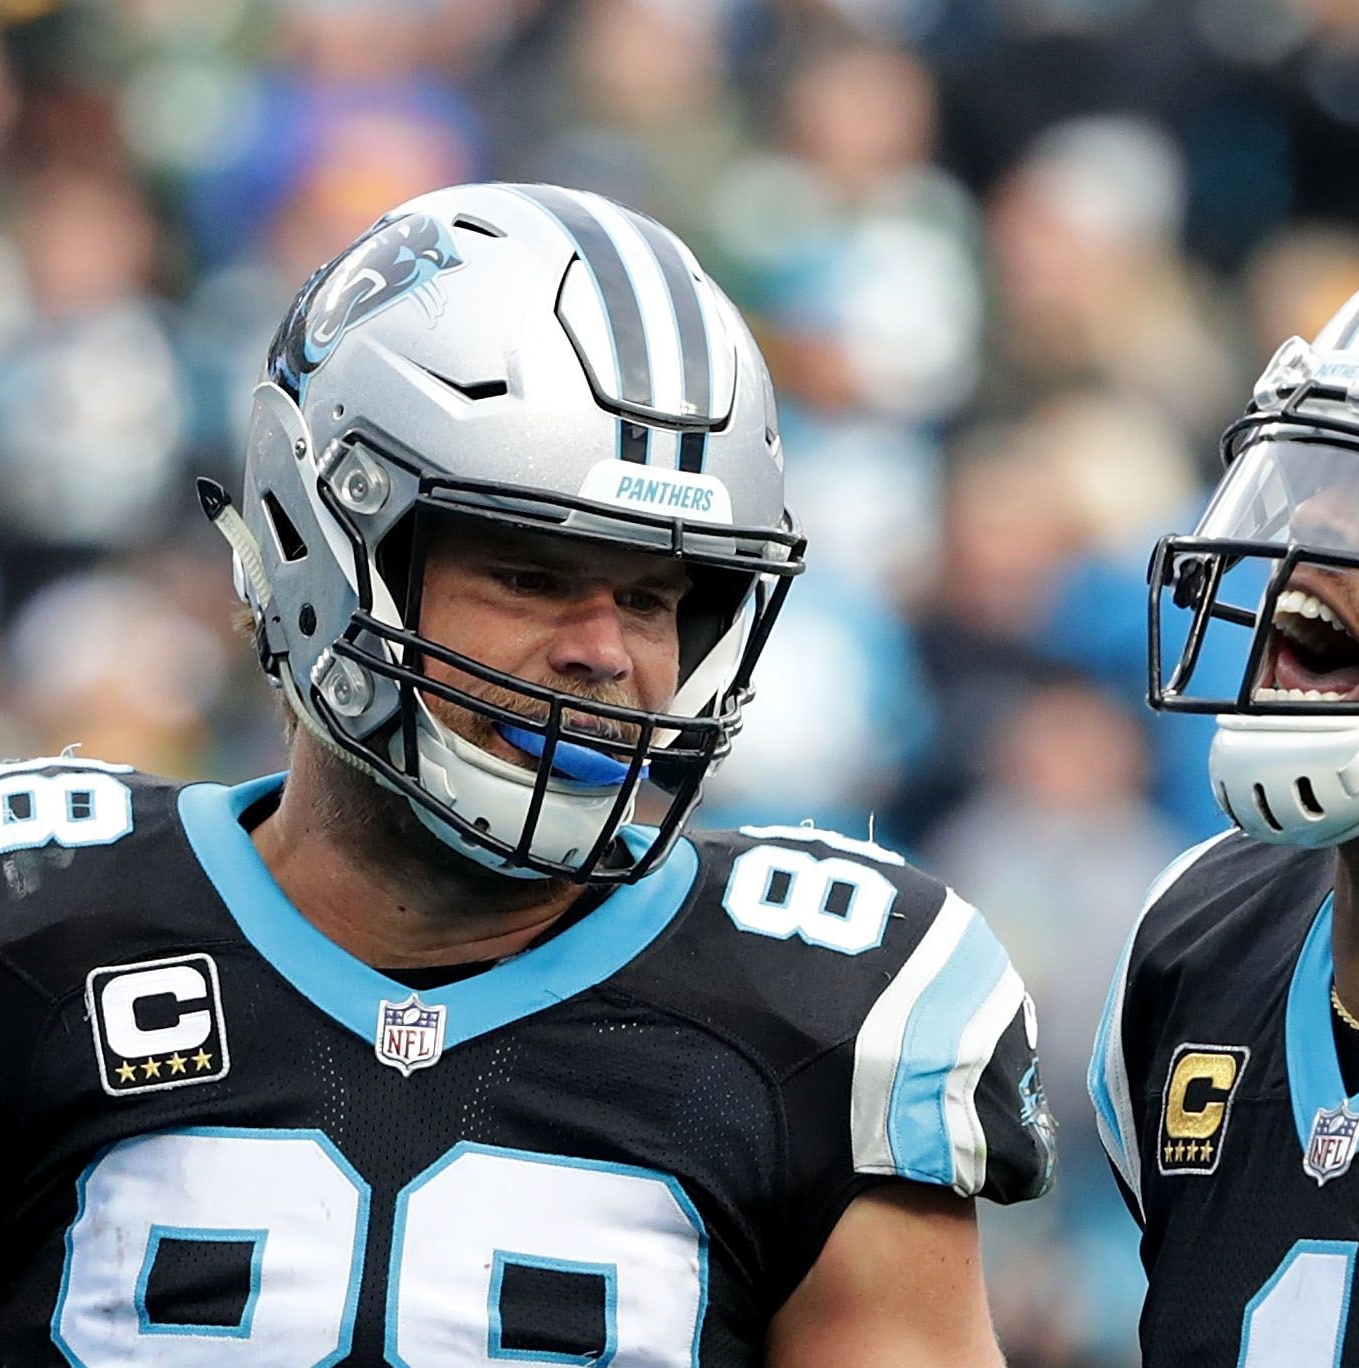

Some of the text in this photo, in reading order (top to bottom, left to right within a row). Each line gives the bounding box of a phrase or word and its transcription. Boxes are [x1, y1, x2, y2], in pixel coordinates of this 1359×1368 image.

[616, 476, 714, 512] PANTHERS
[101, 966, 212, 1058] C
[387, 1029, 430, 1059] NFL
[1166, 1053, 1236, 1138] C
[1311, 1138, 1342, 1168] NFL
